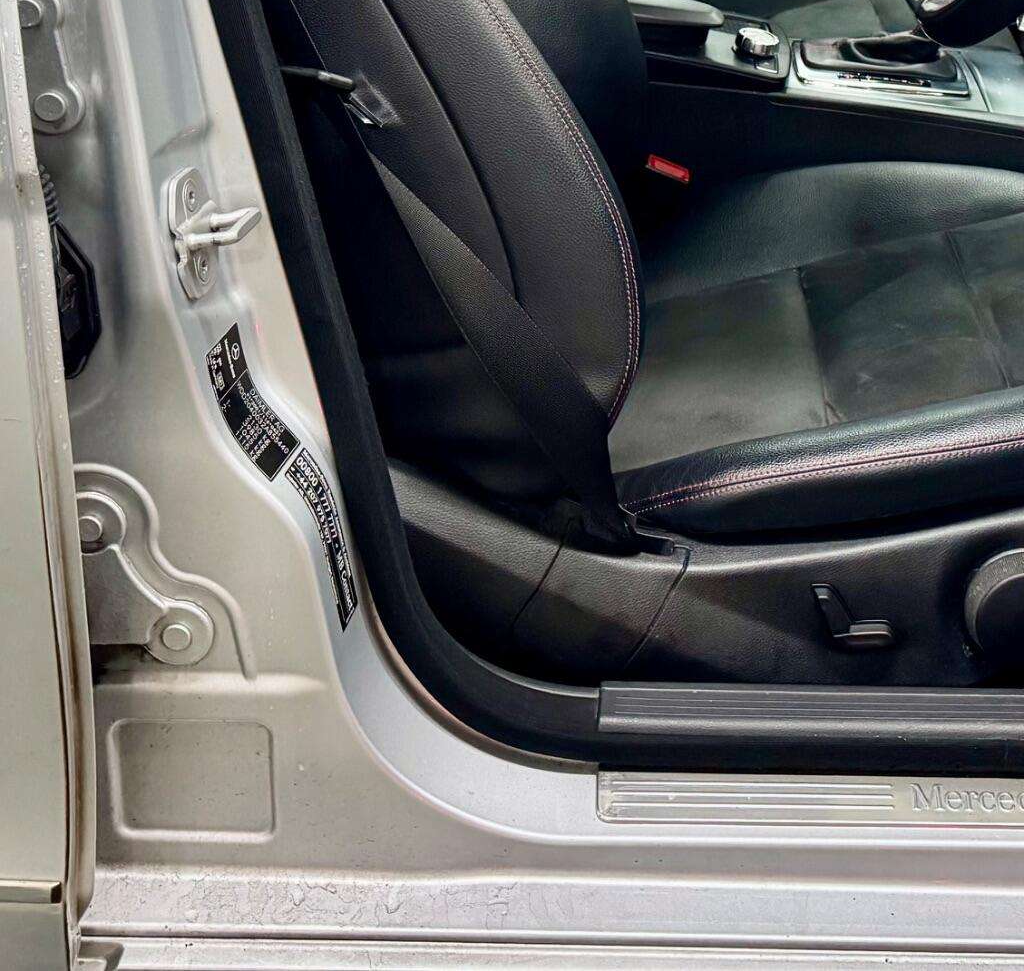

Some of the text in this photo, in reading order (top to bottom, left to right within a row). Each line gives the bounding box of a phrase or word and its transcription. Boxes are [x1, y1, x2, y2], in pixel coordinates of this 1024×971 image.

[249, 388, 285, 433] DAIMLER AG
[297, 456, 318, 486] 00800
[315, 486, 324, 494] 1
[318, 493, 332, 512] 777
[328, 513, 338, 538] 7777
[341, 570, 353, 611] Contact
